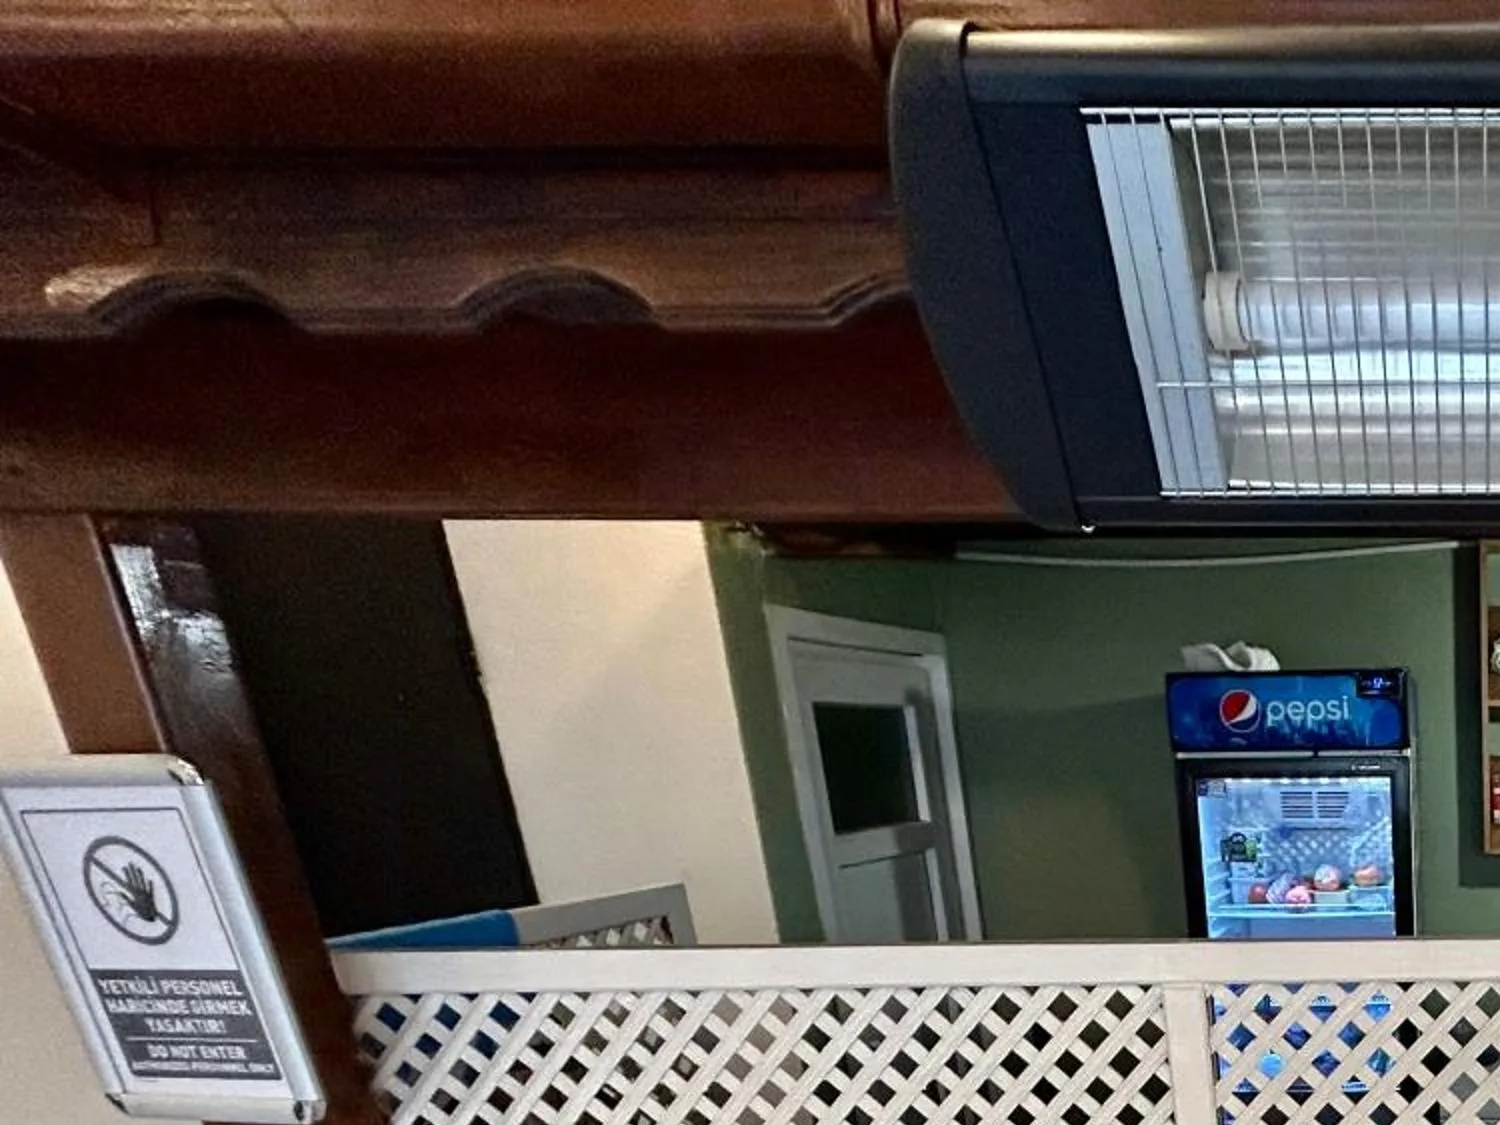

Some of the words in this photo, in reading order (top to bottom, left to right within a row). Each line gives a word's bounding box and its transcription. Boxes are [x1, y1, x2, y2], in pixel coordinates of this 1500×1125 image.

[1266, 695, 1349, 728] pepsi
[160, 978, 243, 995] PERSONEL
[147, 1043, 168, 1059] DO
[169, 1044, 198, 1059] NOT
[200, 1045, 247, 1059] ENTER
